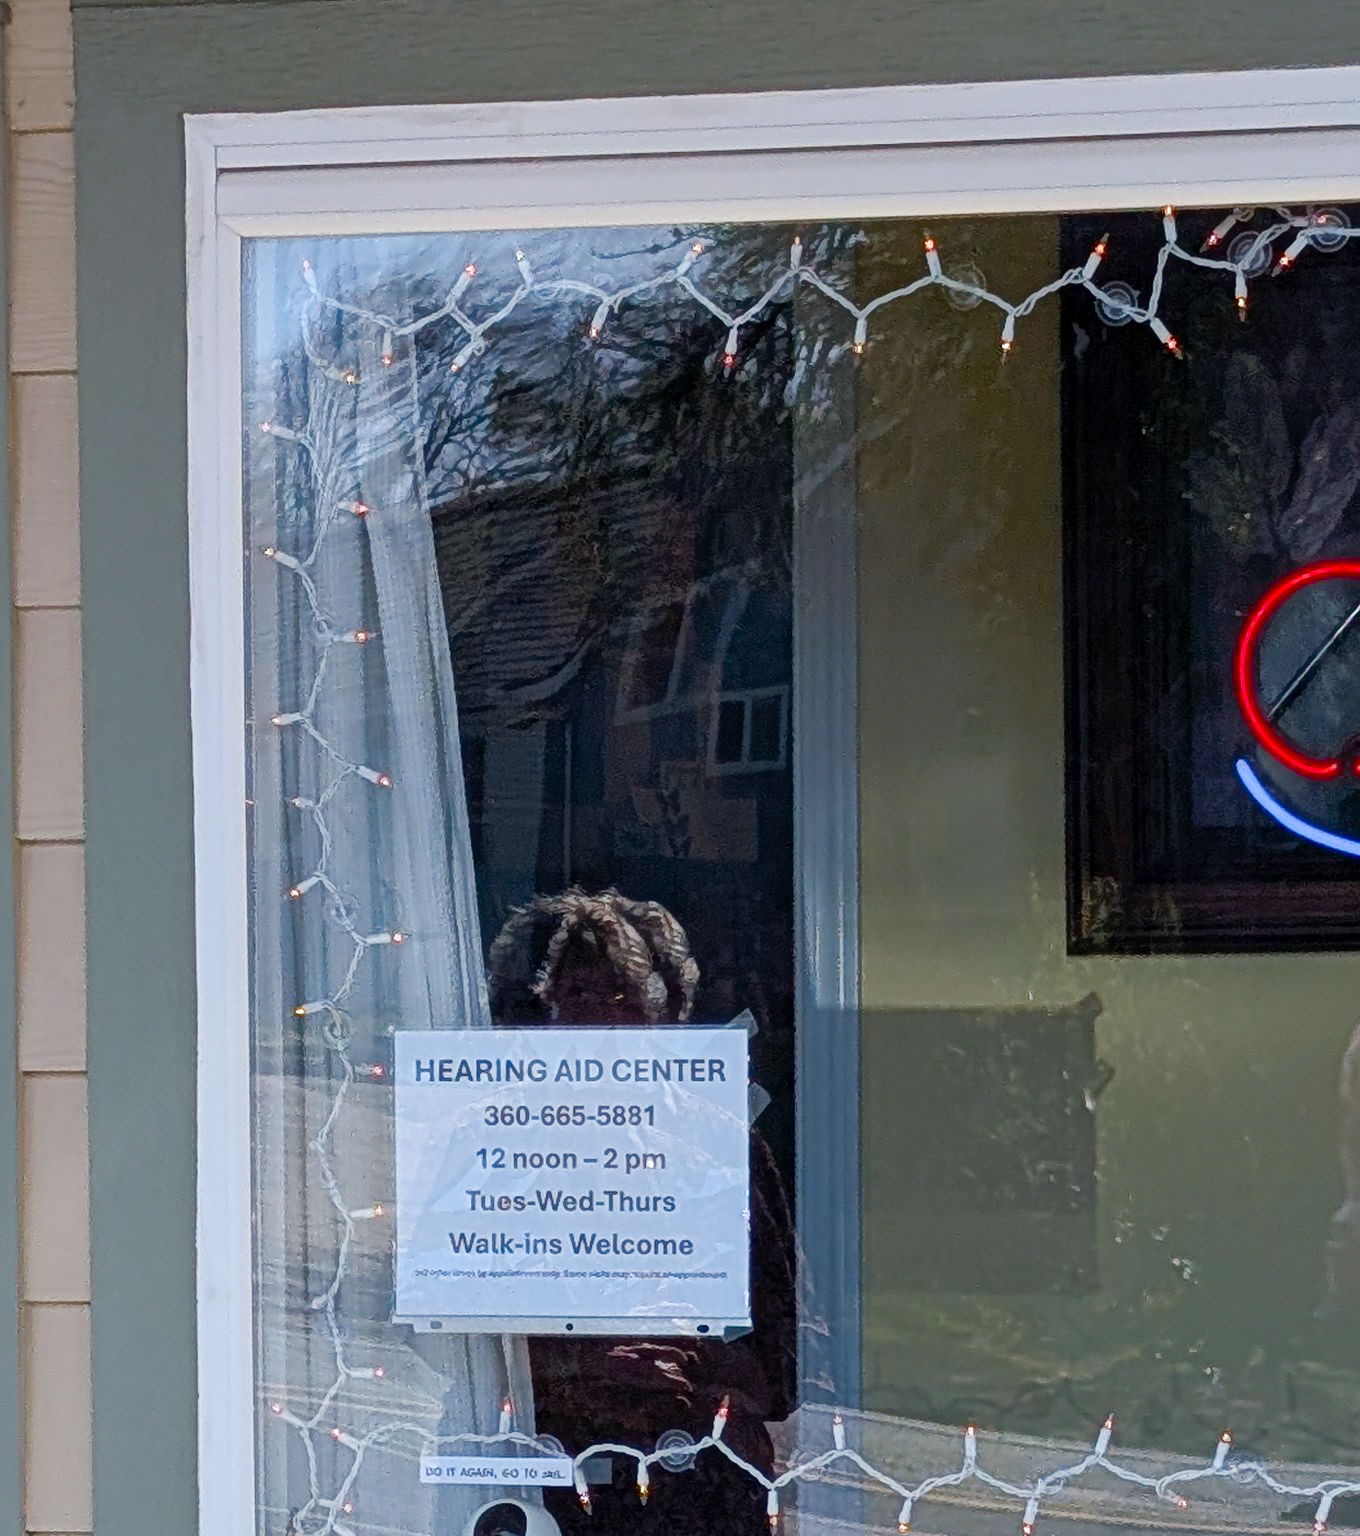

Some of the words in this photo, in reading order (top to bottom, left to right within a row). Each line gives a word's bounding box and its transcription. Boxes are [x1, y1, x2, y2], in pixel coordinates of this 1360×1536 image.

[415, 1059, 547, 1082] HEARING
[554, 1059, 604, 1082] AID
[611, 1059, 726, 1082] CENTER
[484, 1106, 655, 1126] 360-665-5881
[477, 1149, 506, 1169] 12
[513, 1152, 577, 1169] noon
[603, 1149, 618, 1169] 2
[625, 1151, 666, 1174] pm
[466, 1190, 676, 1212] Tues-Wed-Thurs
[448, 1232, 562, 1254] Walk-ins
[569, 1232, 694, 1255] Welcome
